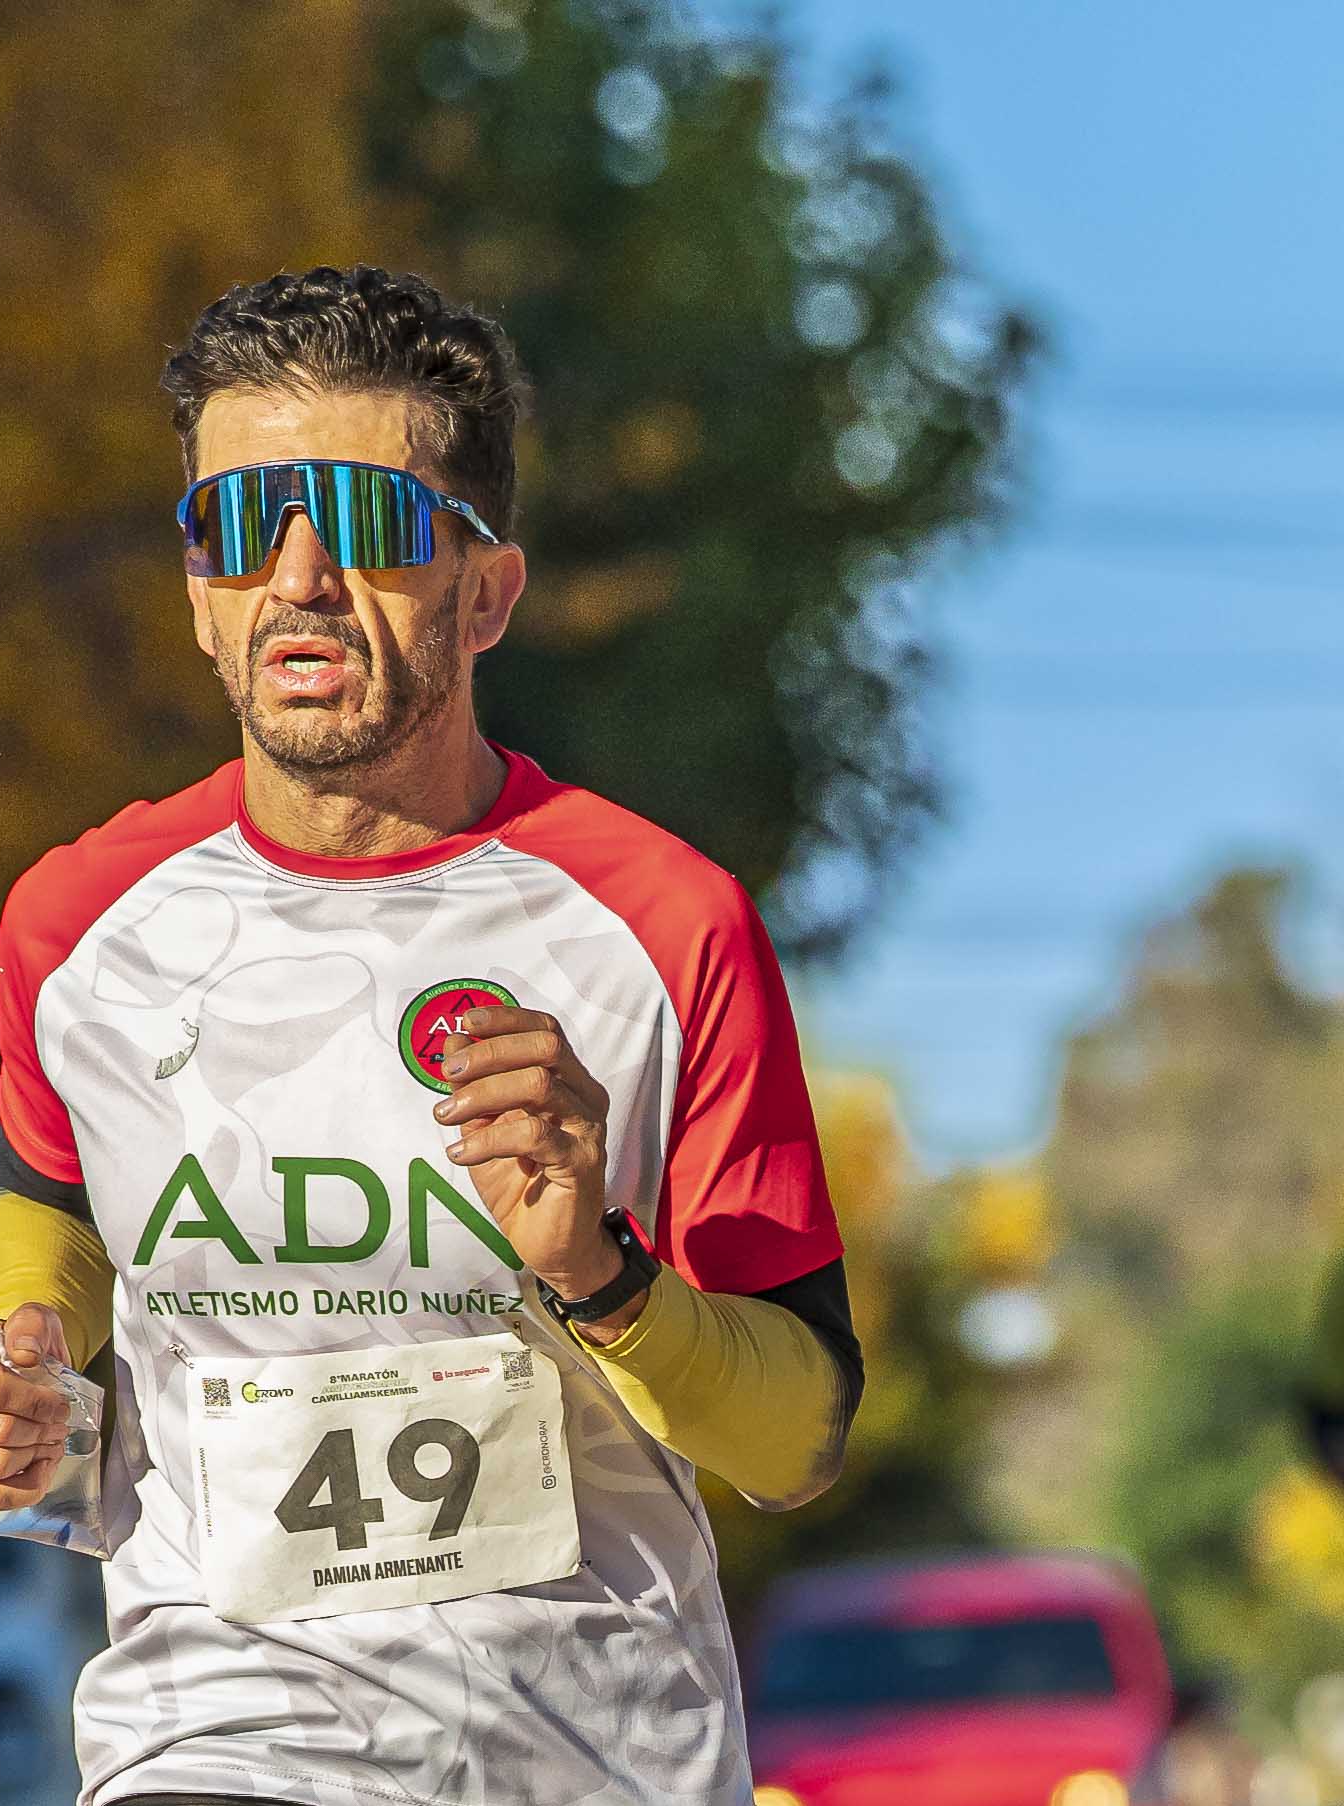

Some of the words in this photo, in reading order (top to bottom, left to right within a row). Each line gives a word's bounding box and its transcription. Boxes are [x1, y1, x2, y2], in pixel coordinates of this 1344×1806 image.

[147, 1290, 298, 1316] ATLETISMO
[314, 1289, 408, 1315] DARIO
[422, 1288, 524, 1315] NUÑEZ
[274, 1418, 481, 1551] 49
[313, 1562, 371, 1588] DAMIAN
[374, 1551, 464, 1580] ARMENANTE
